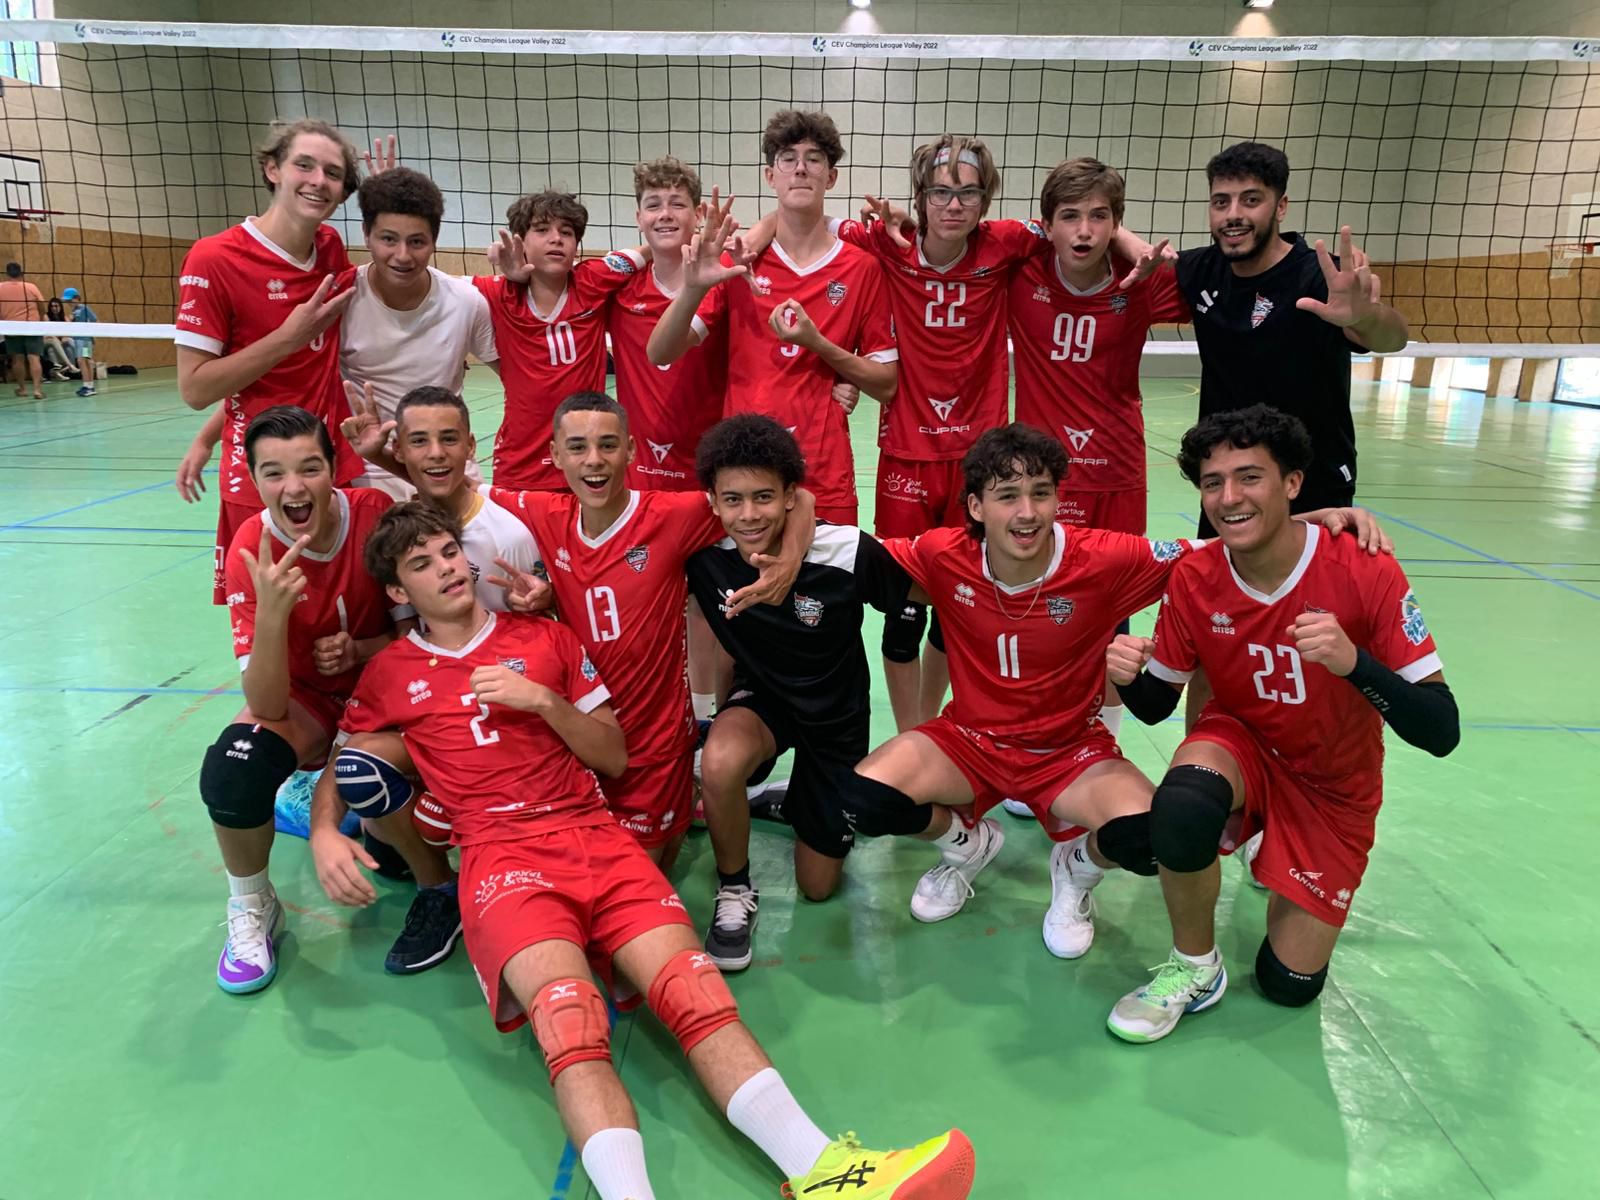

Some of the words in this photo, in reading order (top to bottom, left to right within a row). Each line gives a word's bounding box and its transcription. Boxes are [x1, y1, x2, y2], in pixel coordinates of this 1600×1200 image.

[105, 28, 138, 37] Champions
[140, 29, 161, 37] League
[474, 36, 507, 45] Champions
[508, 37, 531, 45] League
[532, 37, 550, 45] Volley
[846, 41, 879, 49] Champions
[880, 42, 902, 50] League
[904, 42, 921, 50] Volley
[1222, 44, 1257, 52] Champions
[1258, 45, 1280, 53] League
[1282, 45, 1301, 53] Volley
[925, 280, 966, 327] 22
[545, 320, 577, 366] 10
[1050, 312, 1097, 363] 99
[919, 425, 970, 434] CUPRA
[636, 465, 685, 479] CUPRA
[954, 593, 975, 608] errea
[585, 586, 621, 642] 13
[1212, 625, 1235, 635] errea
[997, 632, 1020, 680] 11
[1247, 643, 1307, 705] 23
[410, 689, 433, 705] errea
[459, 692, 501, 747] 2
[226, 750, 249, 760] errea
[620, 818, 654, 832] CANNES
[1288, 867, 1326, 899] CANNES
